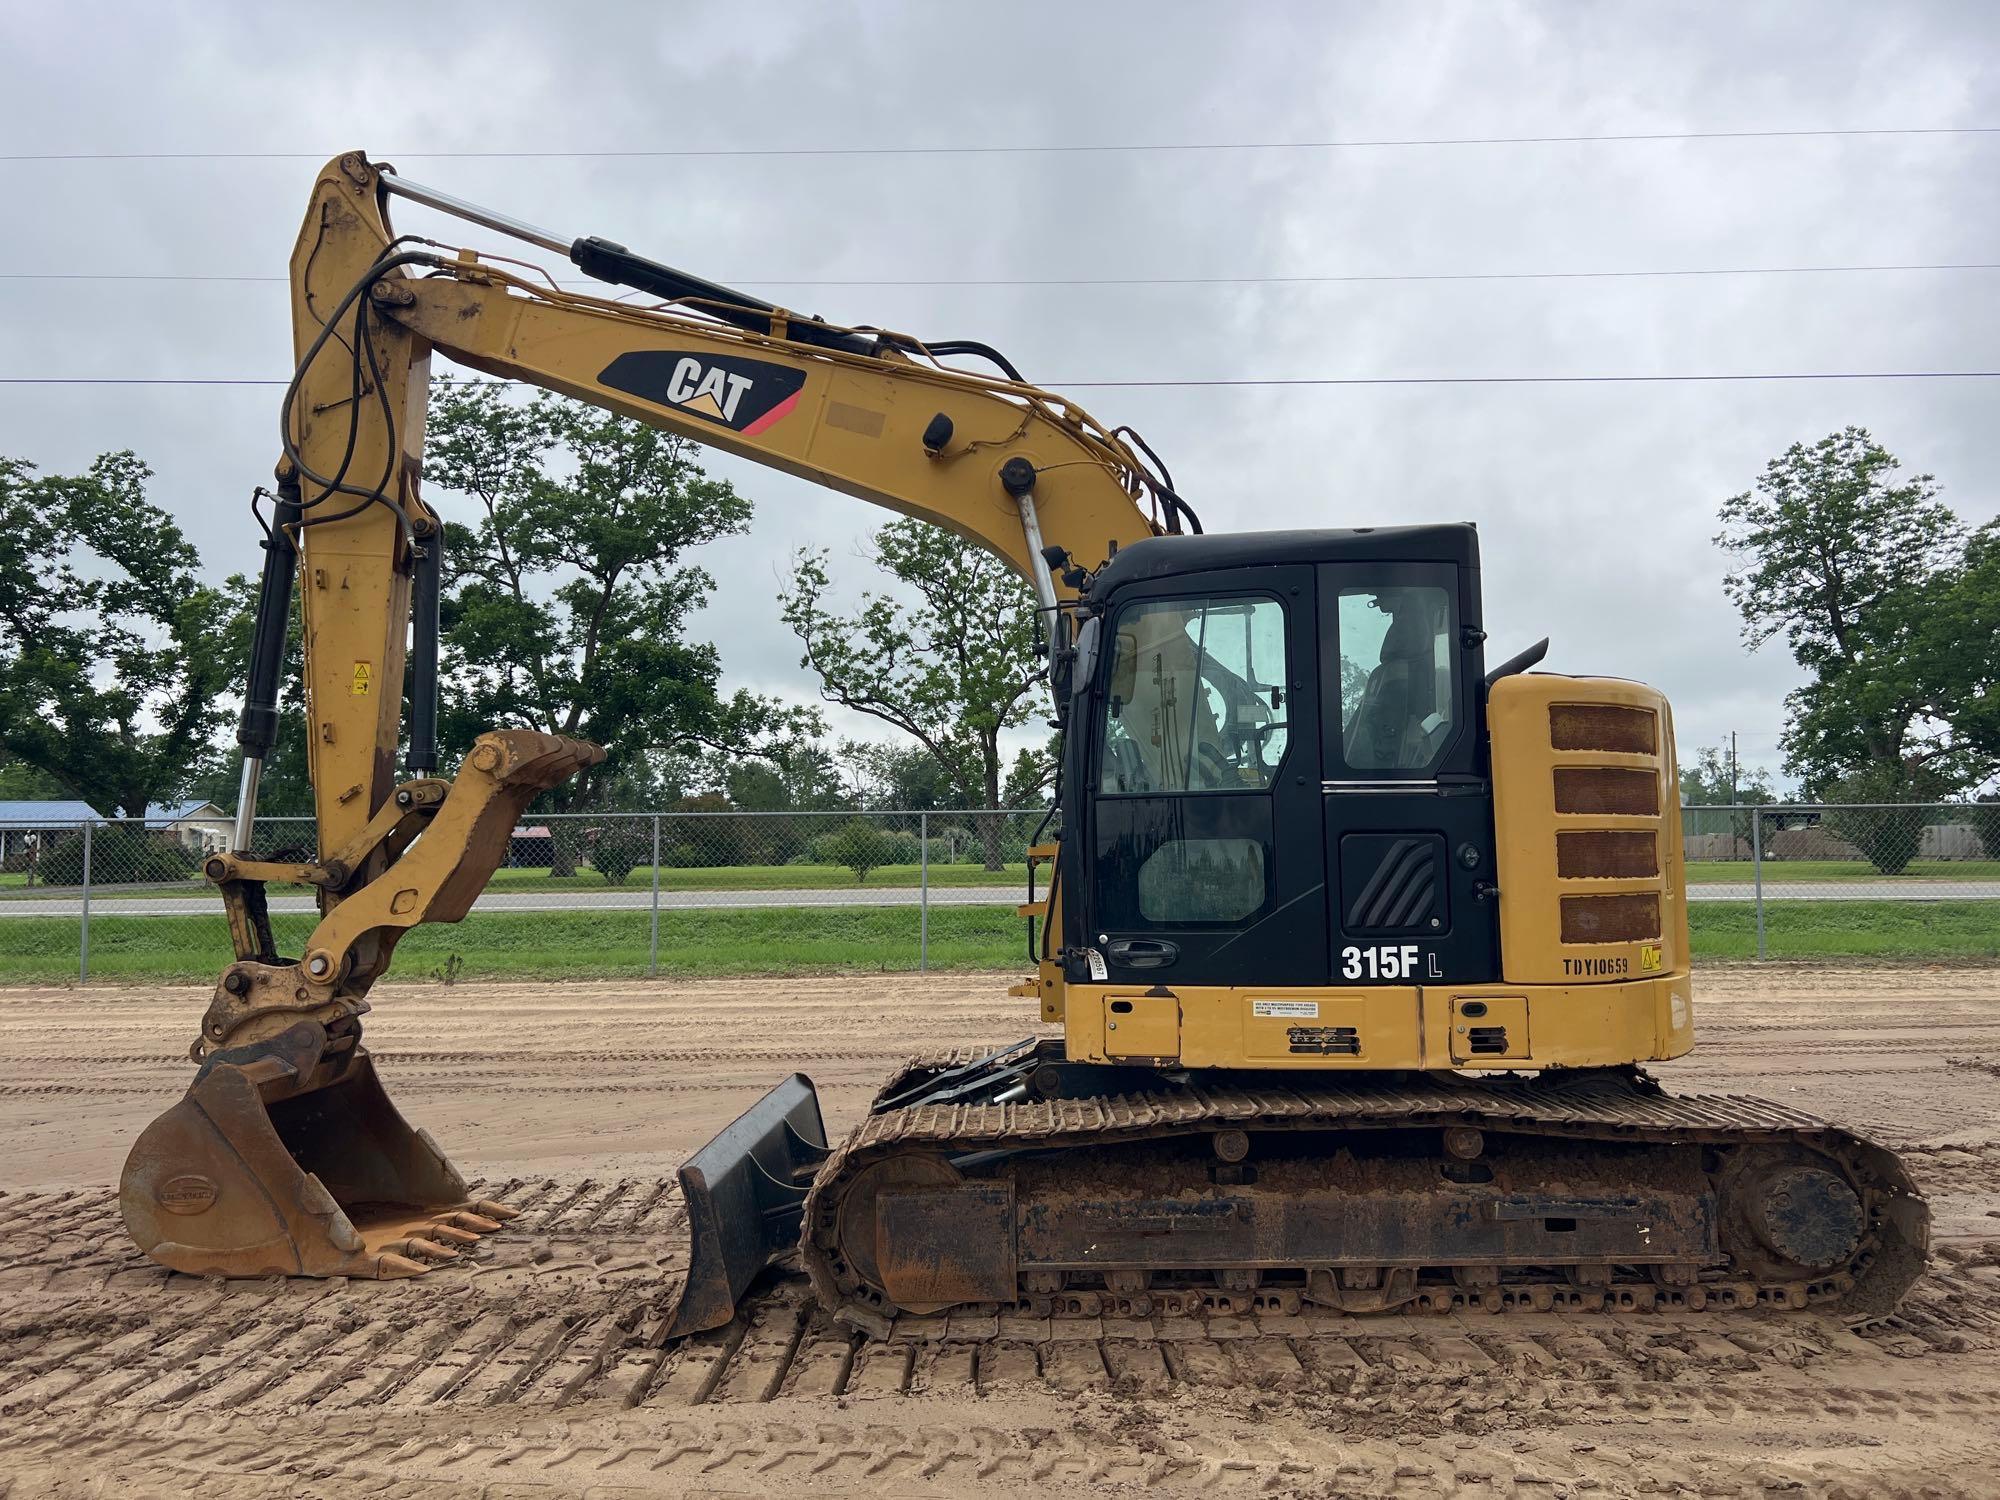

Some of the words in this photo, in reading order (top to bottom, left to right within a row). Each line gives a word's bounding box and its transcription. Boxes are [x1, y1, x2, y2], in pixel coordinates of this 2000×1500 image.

[666, 357, 753, 422] CAT
[1341, 945, 1418, 979] 315F
[1428, 952, 1443, 978] L
